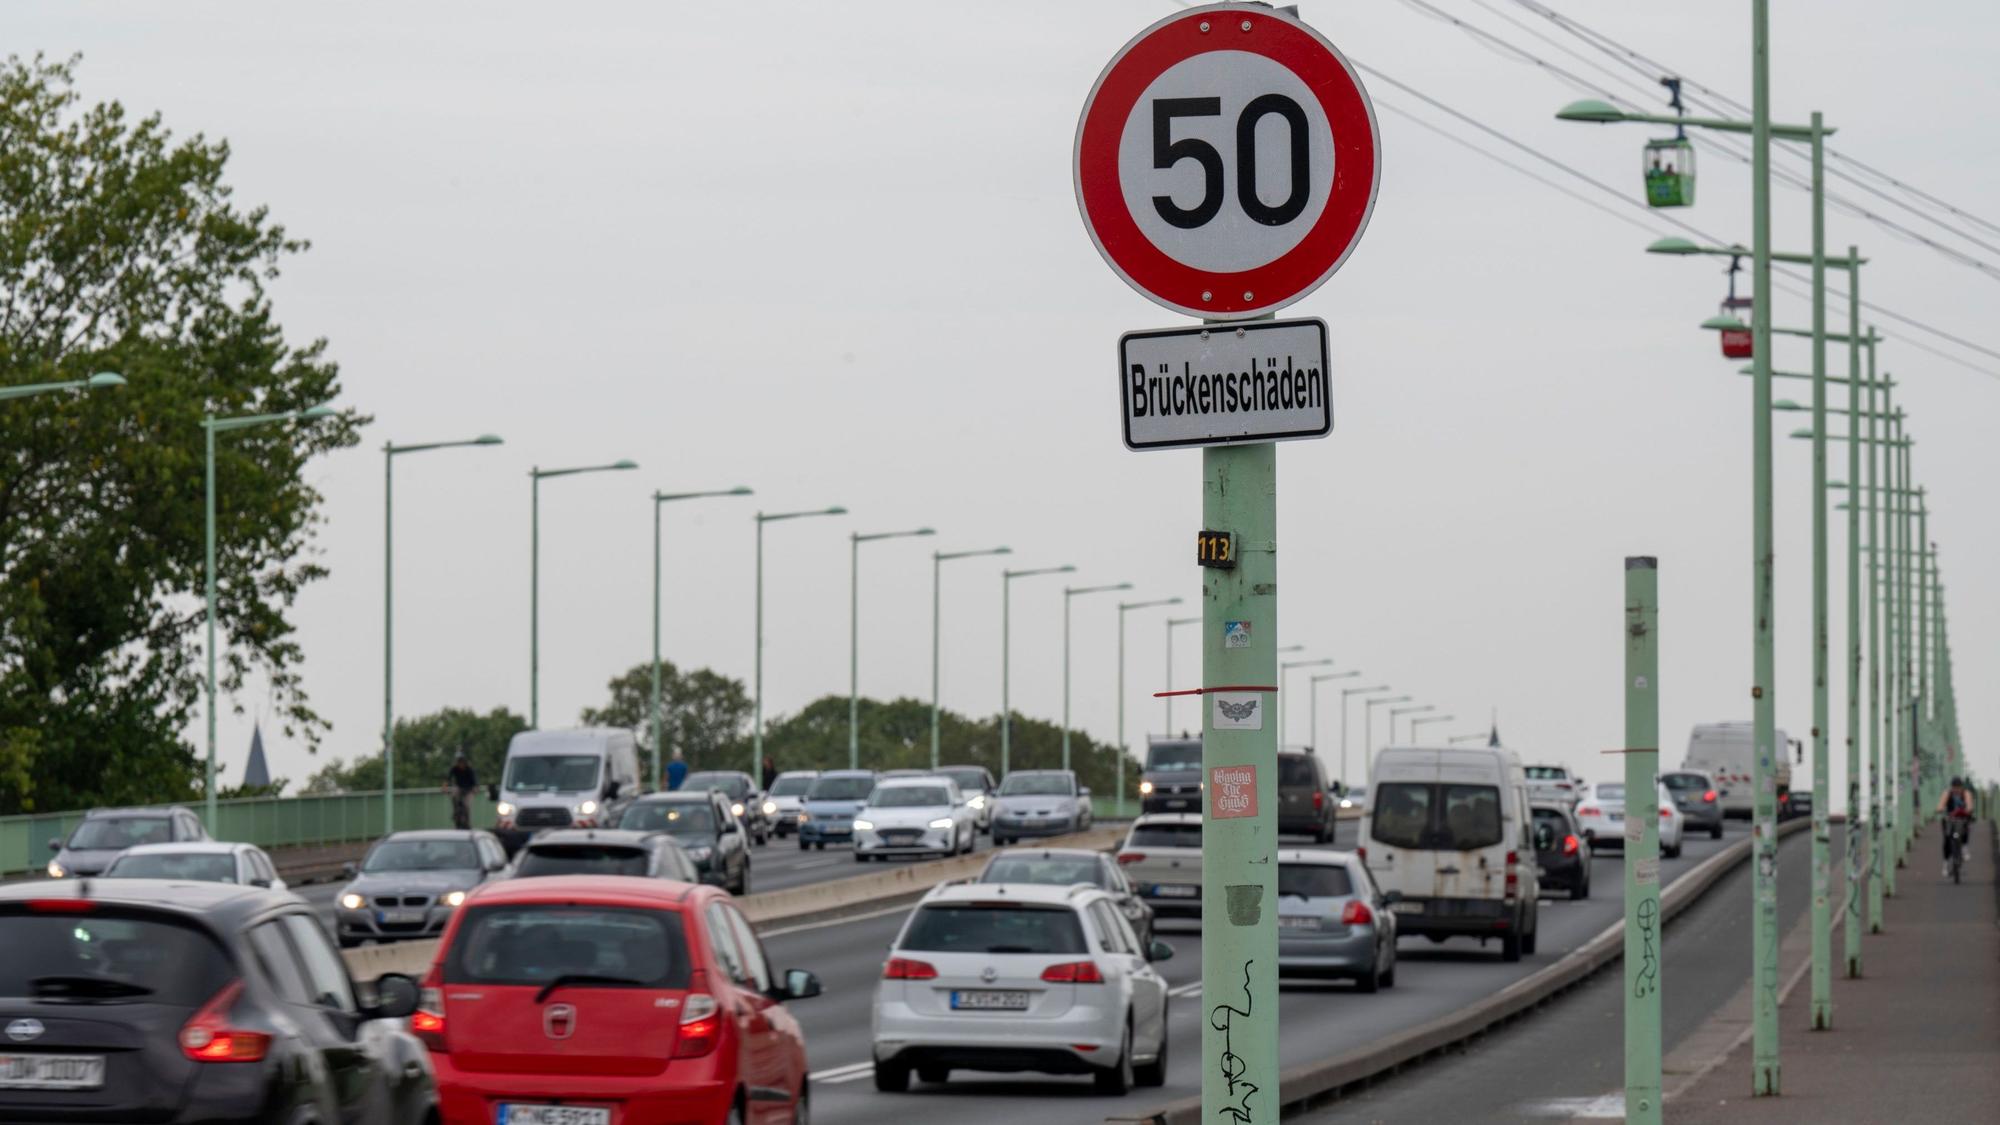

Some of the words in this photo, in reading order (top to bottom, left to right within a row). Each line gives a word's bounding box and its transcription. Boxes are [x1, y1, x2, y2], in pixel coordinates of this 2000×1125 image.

[1152, 93, 1311, 229] 50
[1131, 356, 1322, 417] Brückenschäden
[1198, 537, 1229, 560] 113
[1222, 783, 1240, 796] The
